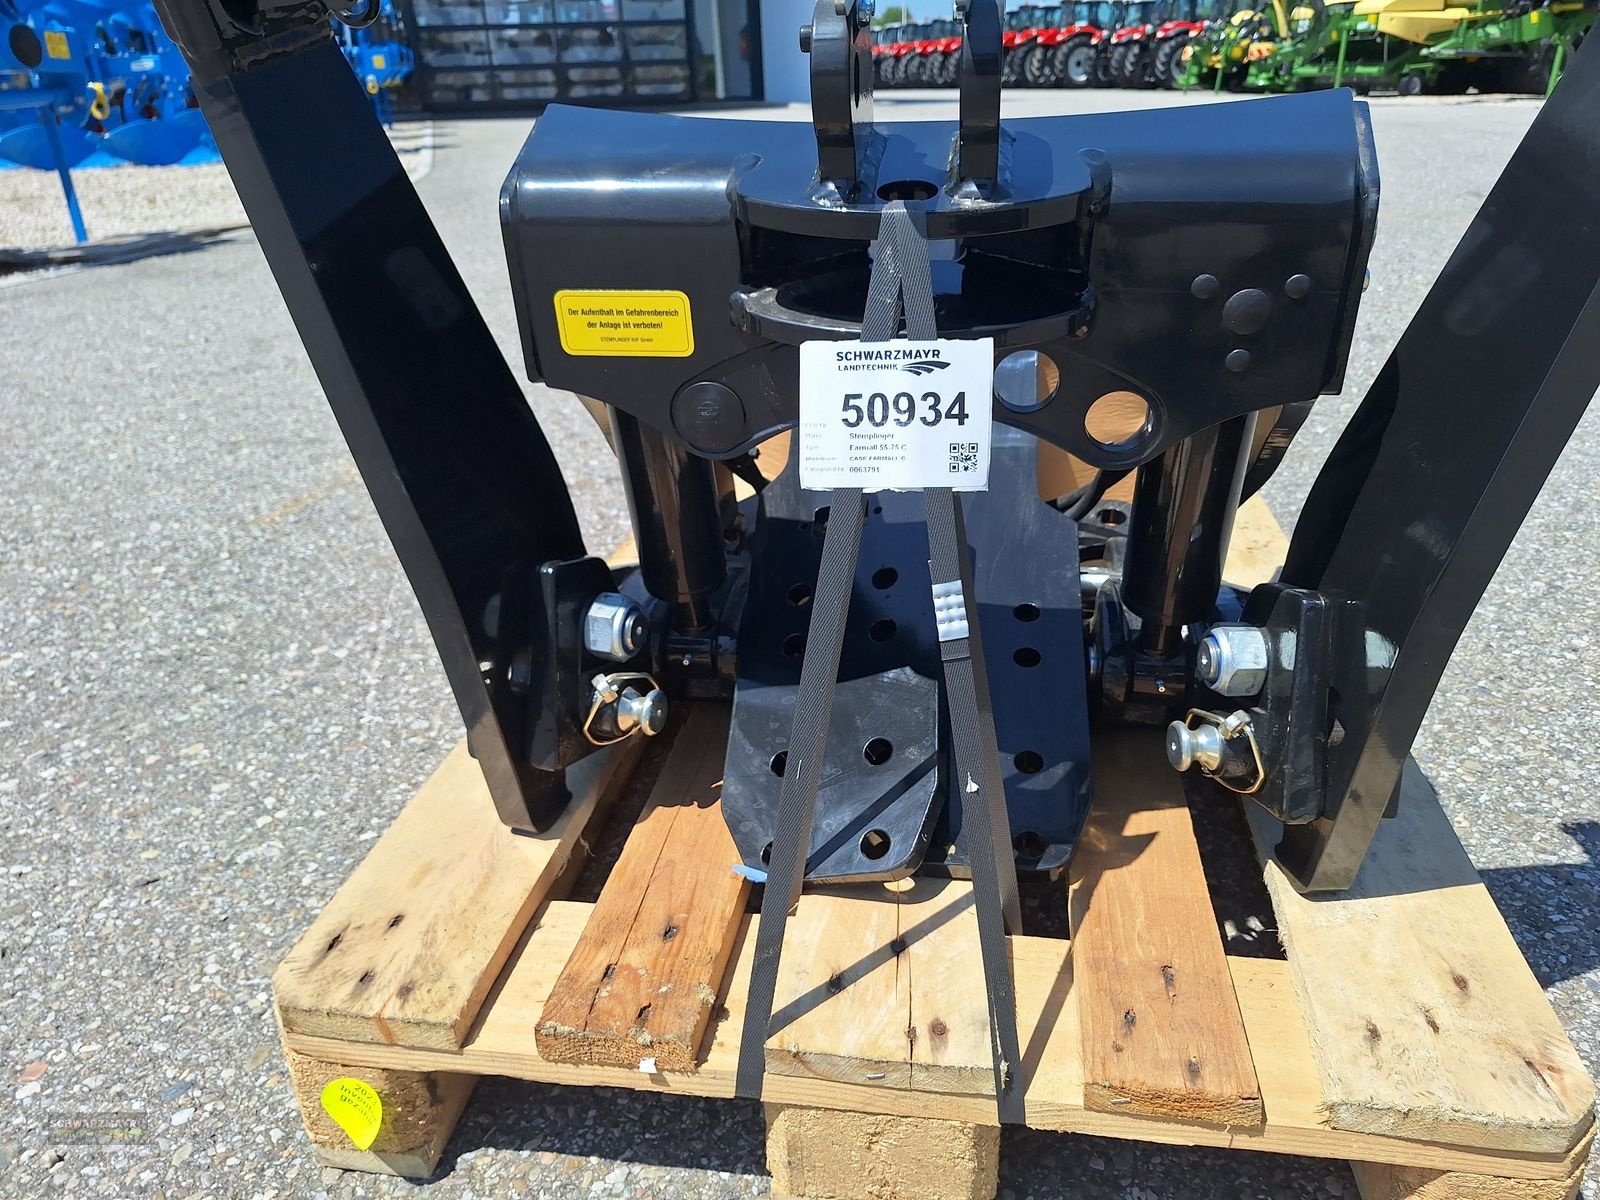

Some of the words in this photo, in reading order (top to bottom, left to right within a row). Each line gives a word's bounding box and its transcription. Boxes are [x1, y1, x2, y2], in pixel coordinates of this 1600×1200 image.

[568, 308, 579, 316] Der
[581, 308, 615, 317] Aufenthalt
[615, 308, 624, 317] im
[625, 308, 679, 317] Gefahrenbereich
[587, 321, 597, 329] der
[599, 321, 621, 331] Anlage
[622, 321, 632, 329] ist
[633, 321, 663, 329] verboten!
[836, 349, 941, 362] SCHWARZMAYR
[838, 363, 898, 372] LANDTECHNIK
[841, 391, 970, 428] 50934
[849, 432, 895, 441] Stemplinger
